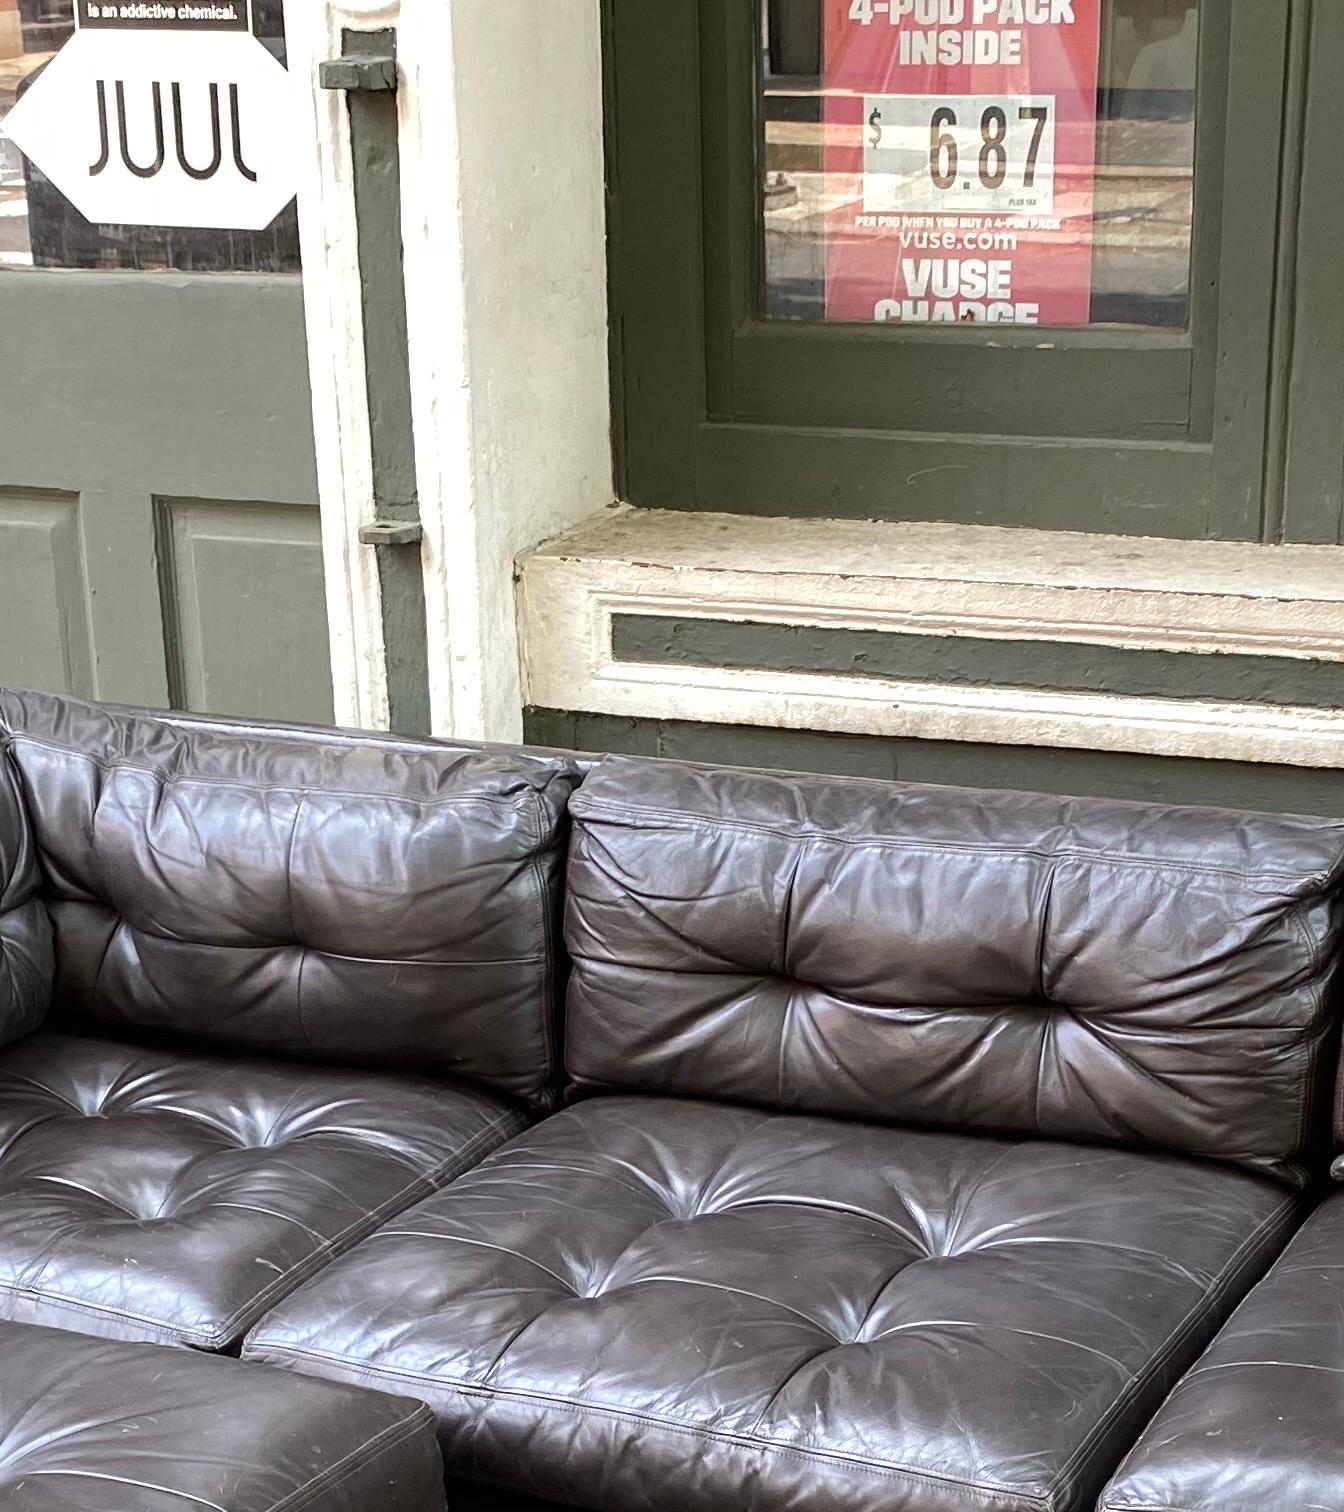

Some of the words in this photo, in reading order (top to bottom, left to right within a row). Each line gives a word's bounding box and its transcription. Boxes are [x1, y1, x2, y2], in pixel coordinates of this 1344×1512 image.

[87, 3, 99, 18] is
[101, 6, 117, 18] an
[120, 4, 175, 19] addictive
[177, 6, 238, 20] chemical.
[973, 0, 1075, 25] PACK
[899, 29, 1022, 66] INSIDE
[88, 79, 258, 184] JUUL
[868, 107, 882, 150] $
[929, 105, 1048, 190] 6.87
[899, 230, 1018, 251] vuse.com
[902, 258, 1013, 300] VUSE
